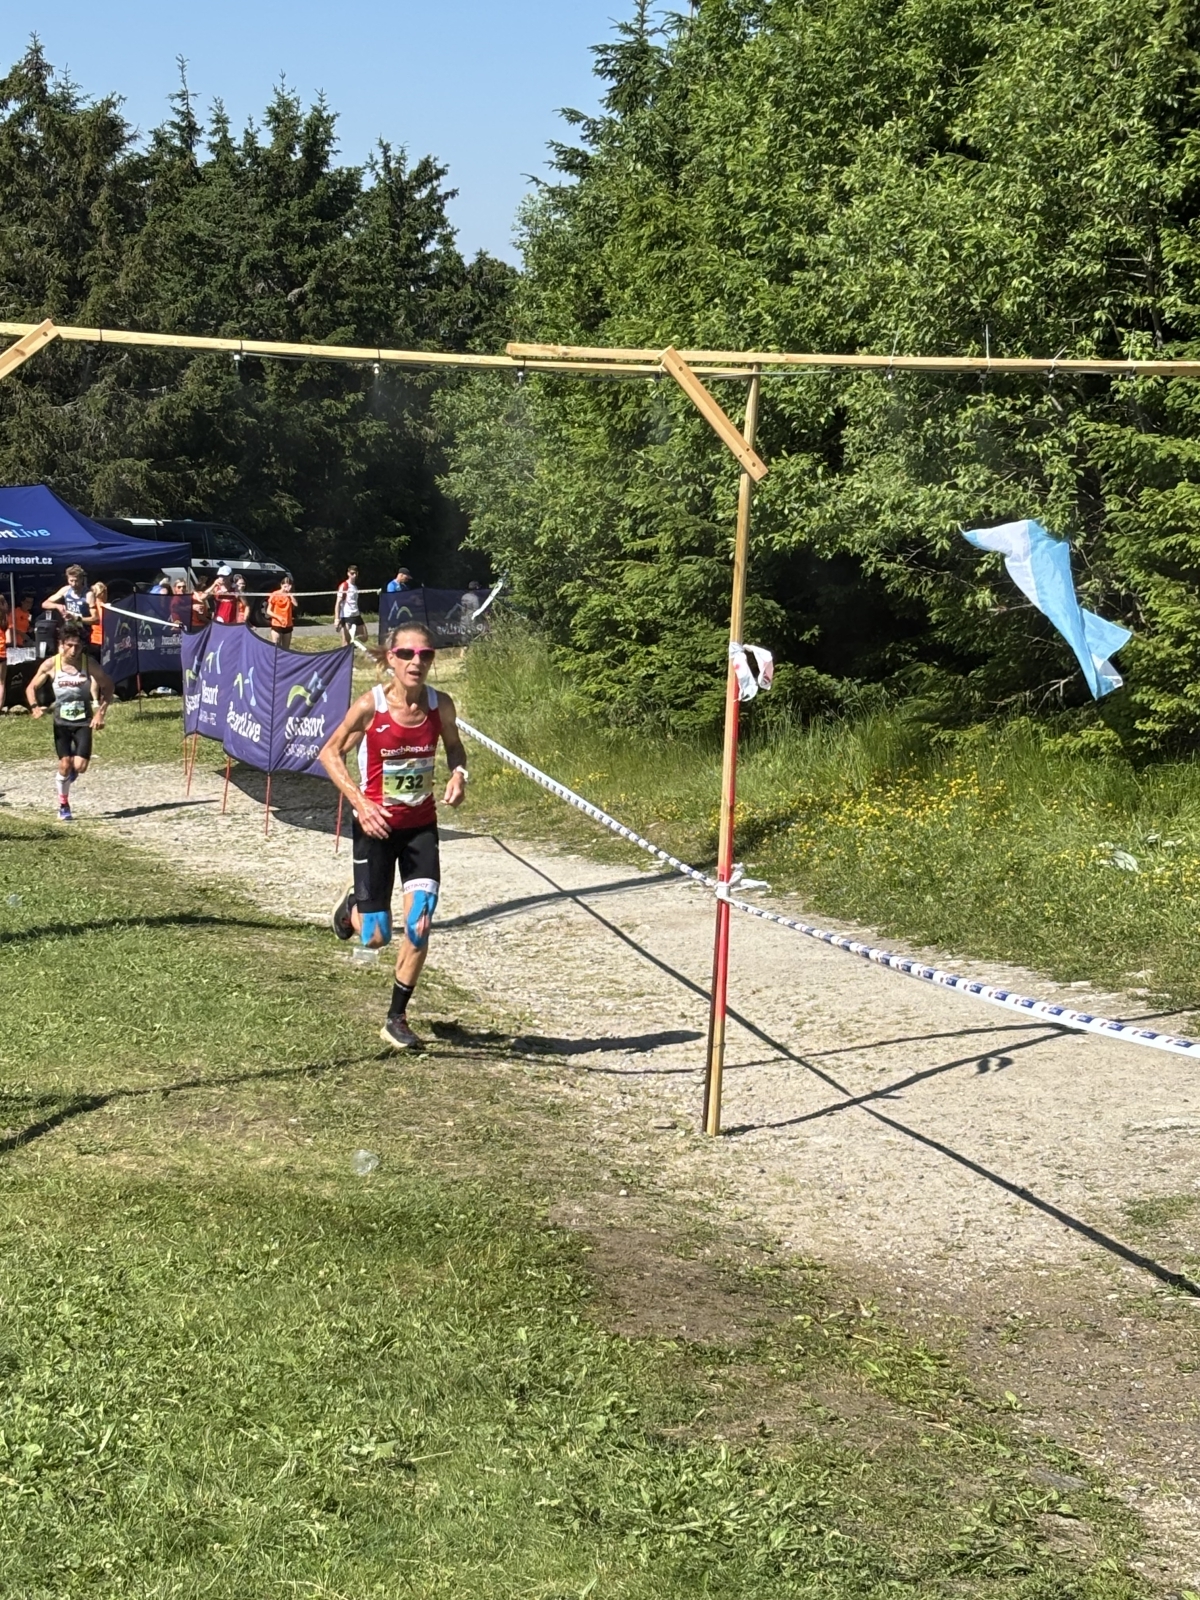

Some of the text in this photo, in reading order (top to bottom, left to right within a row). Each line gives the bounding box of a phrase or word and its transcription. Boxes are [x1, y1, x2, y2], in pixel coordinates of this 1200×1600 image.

[0, 528, 51, 538] rtLive
[66, 602, 81, 614] USA
[394, 774, 424, 790] 732
